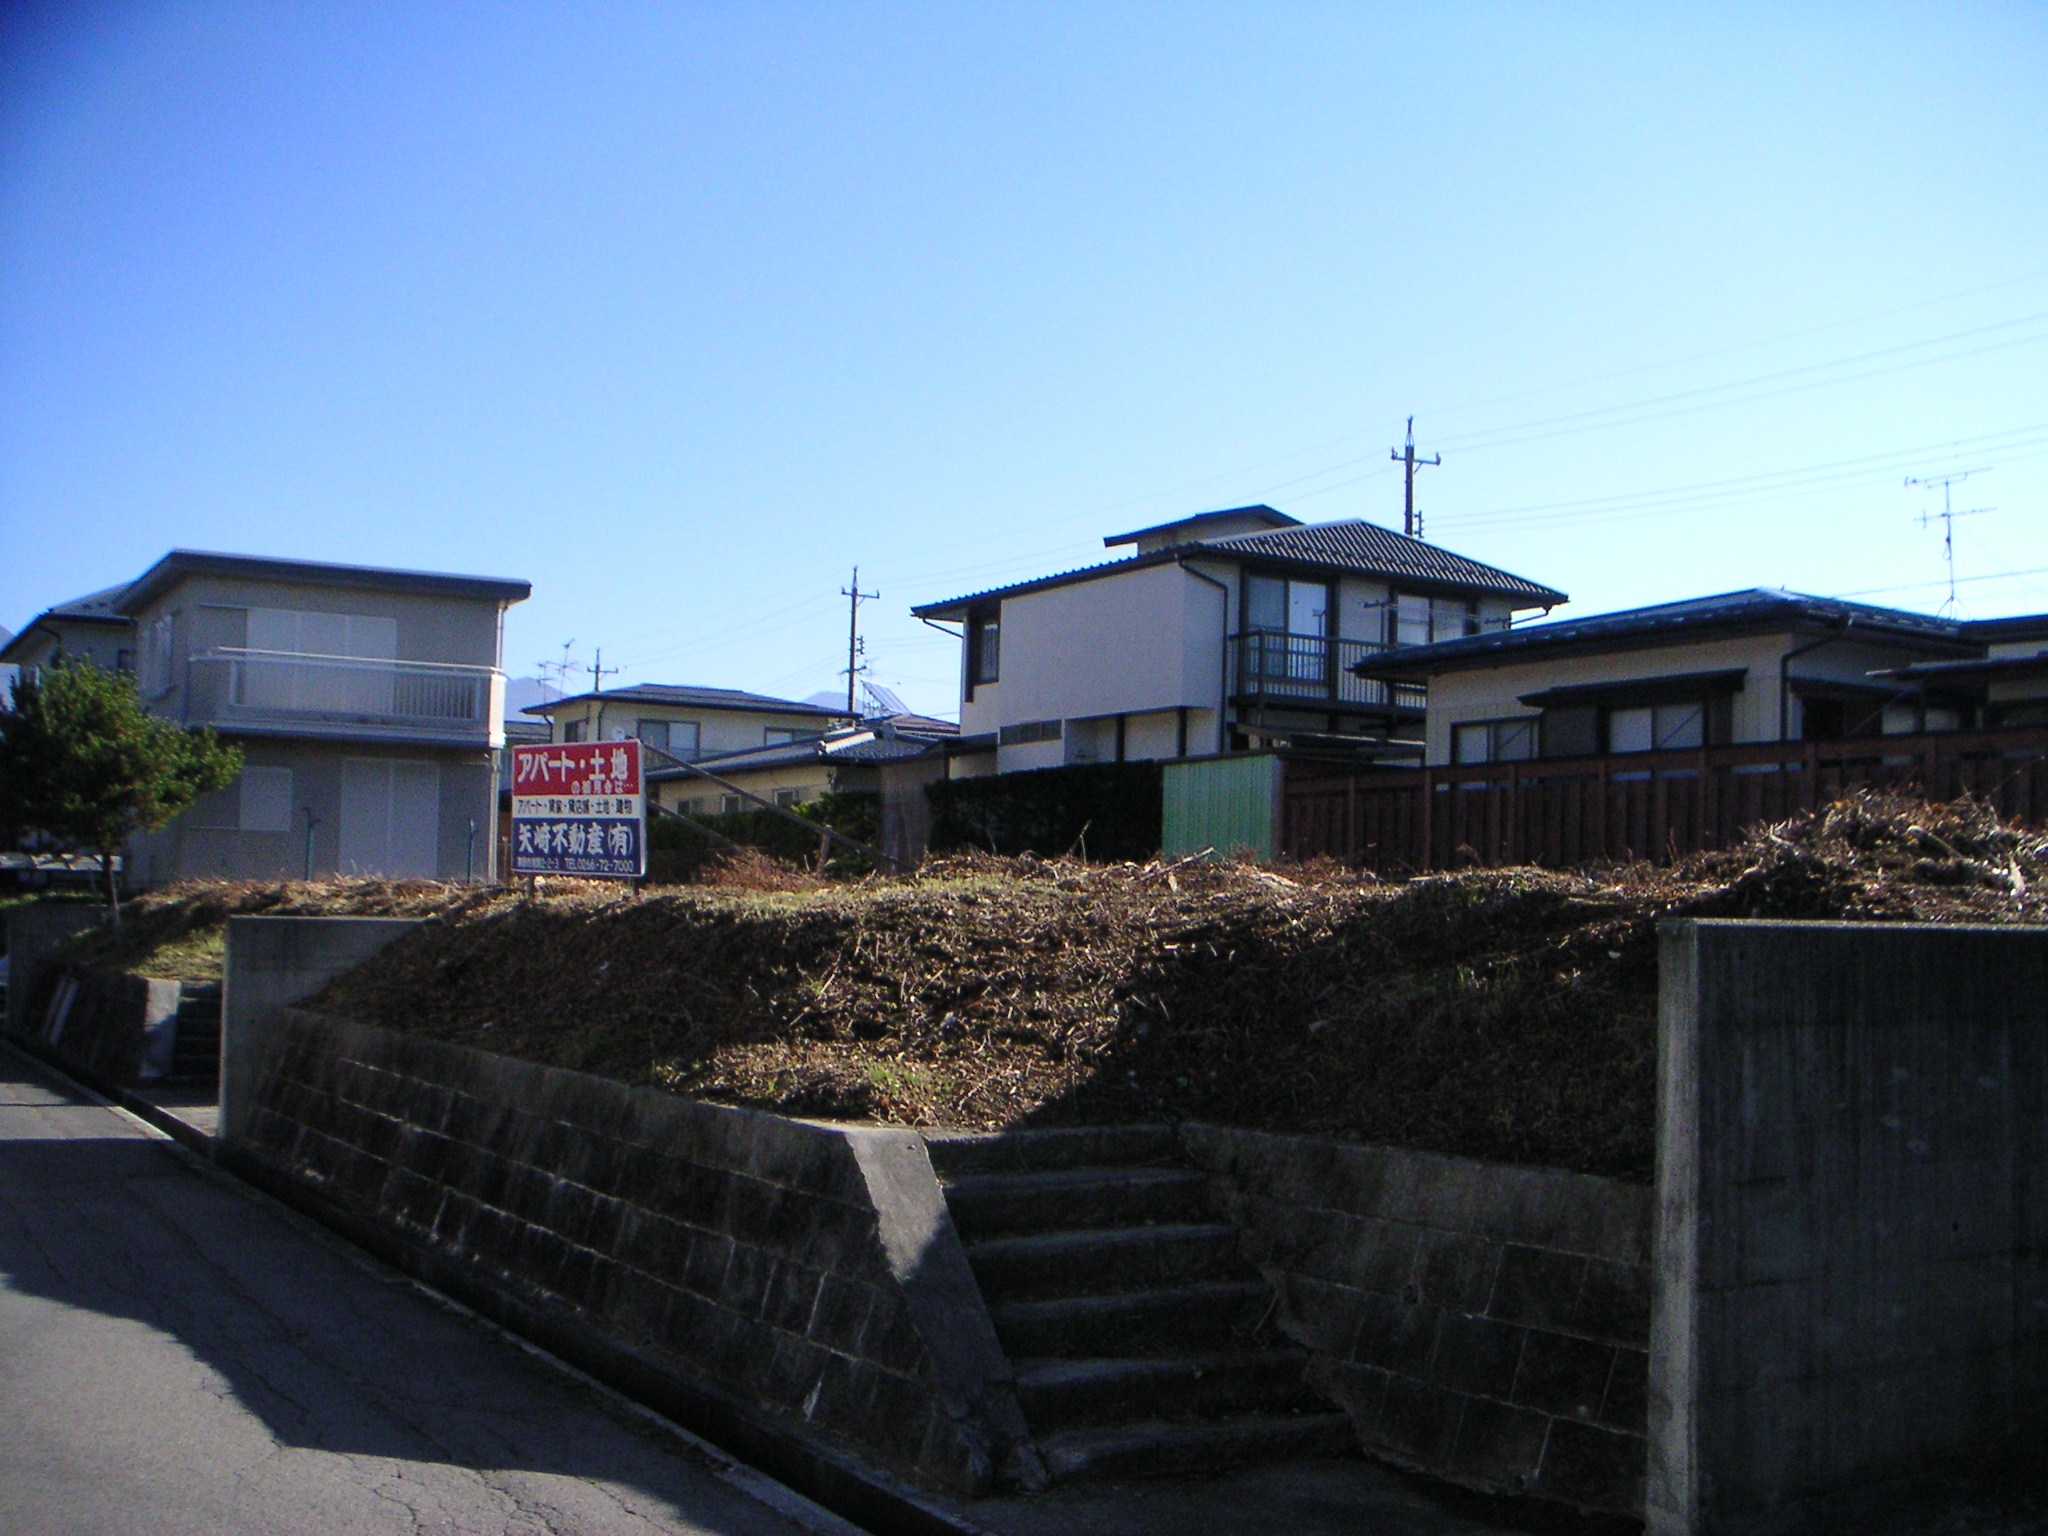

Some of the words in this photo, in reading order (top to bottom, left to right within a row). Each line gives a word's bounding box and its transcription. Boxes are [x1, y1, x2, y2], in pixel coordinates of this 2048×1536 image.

[518, 748, 628, 782] アパート・土地
